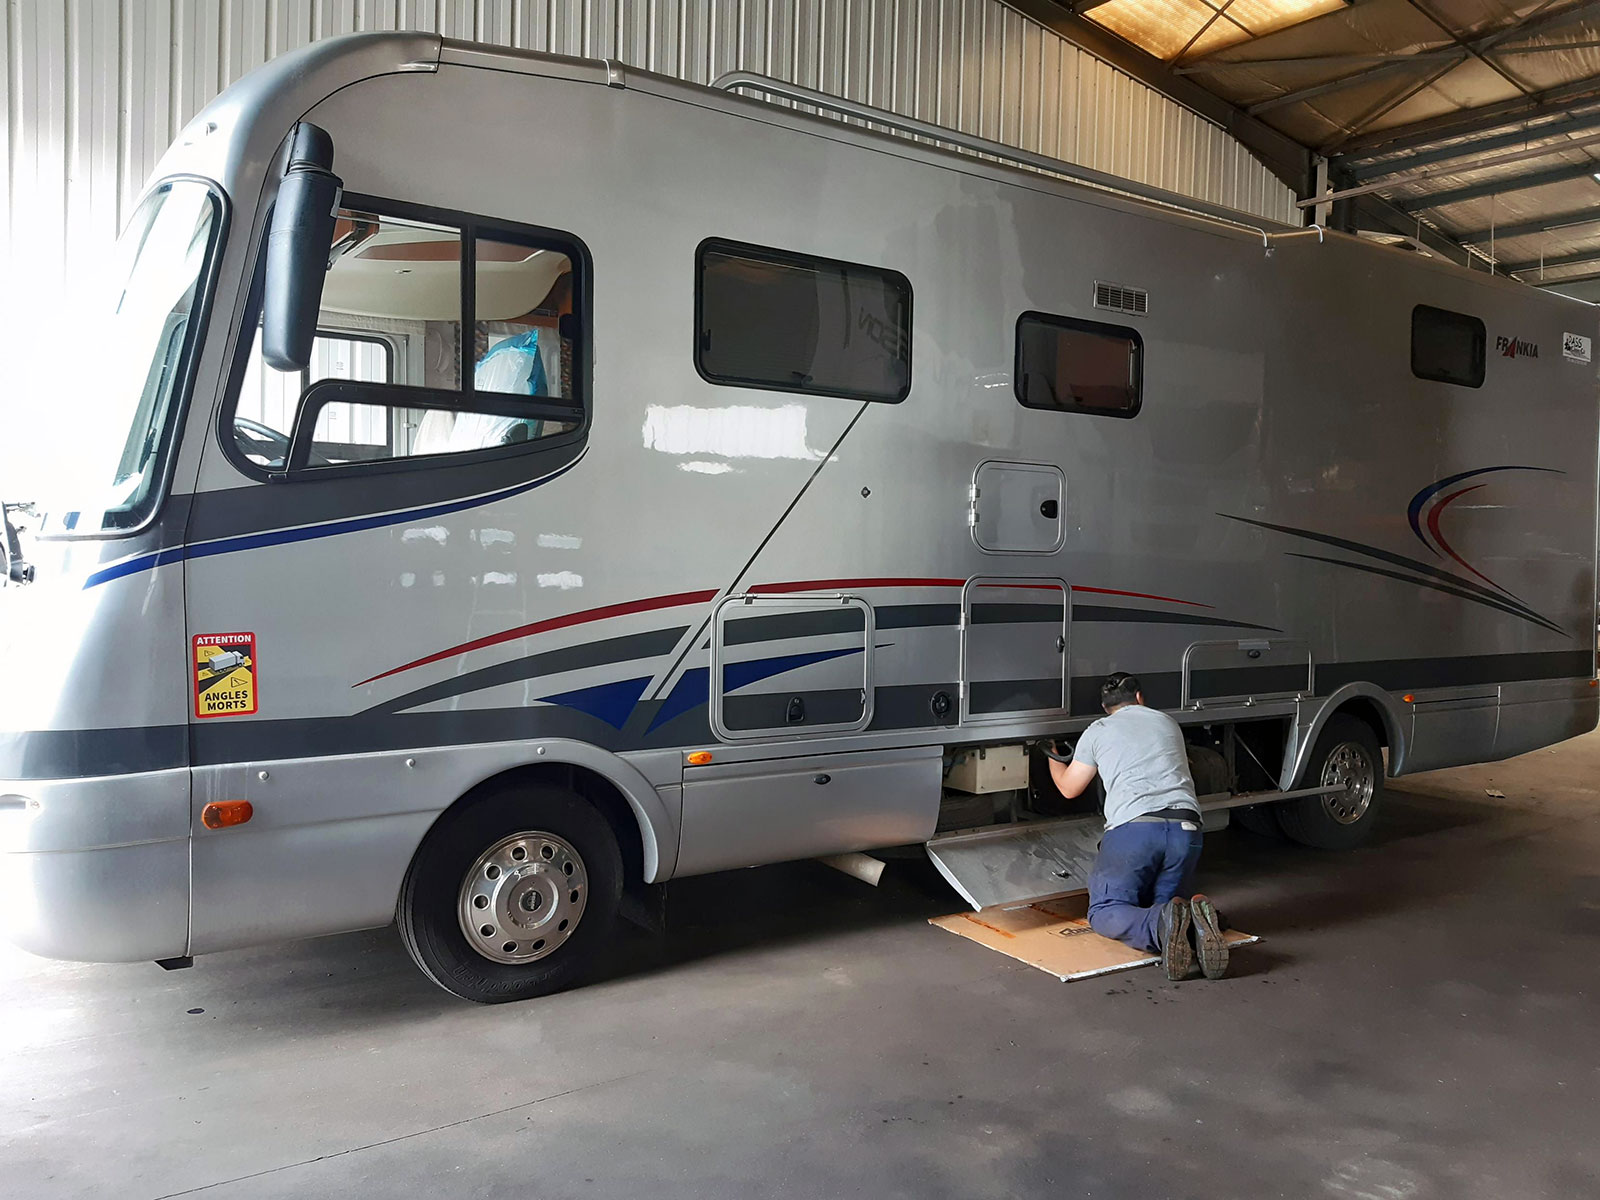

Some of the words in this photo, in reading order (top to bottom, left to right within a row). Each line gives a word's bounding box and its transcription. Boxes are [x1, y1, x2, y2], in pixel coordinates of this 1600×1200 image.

[1496, 336, 1538, 358] FRANKIA
[197, 635, 251, 644] ATTENTION
[205, 690, 248, 701] ANGLES
[208, 700, 246, 711] MORTS
